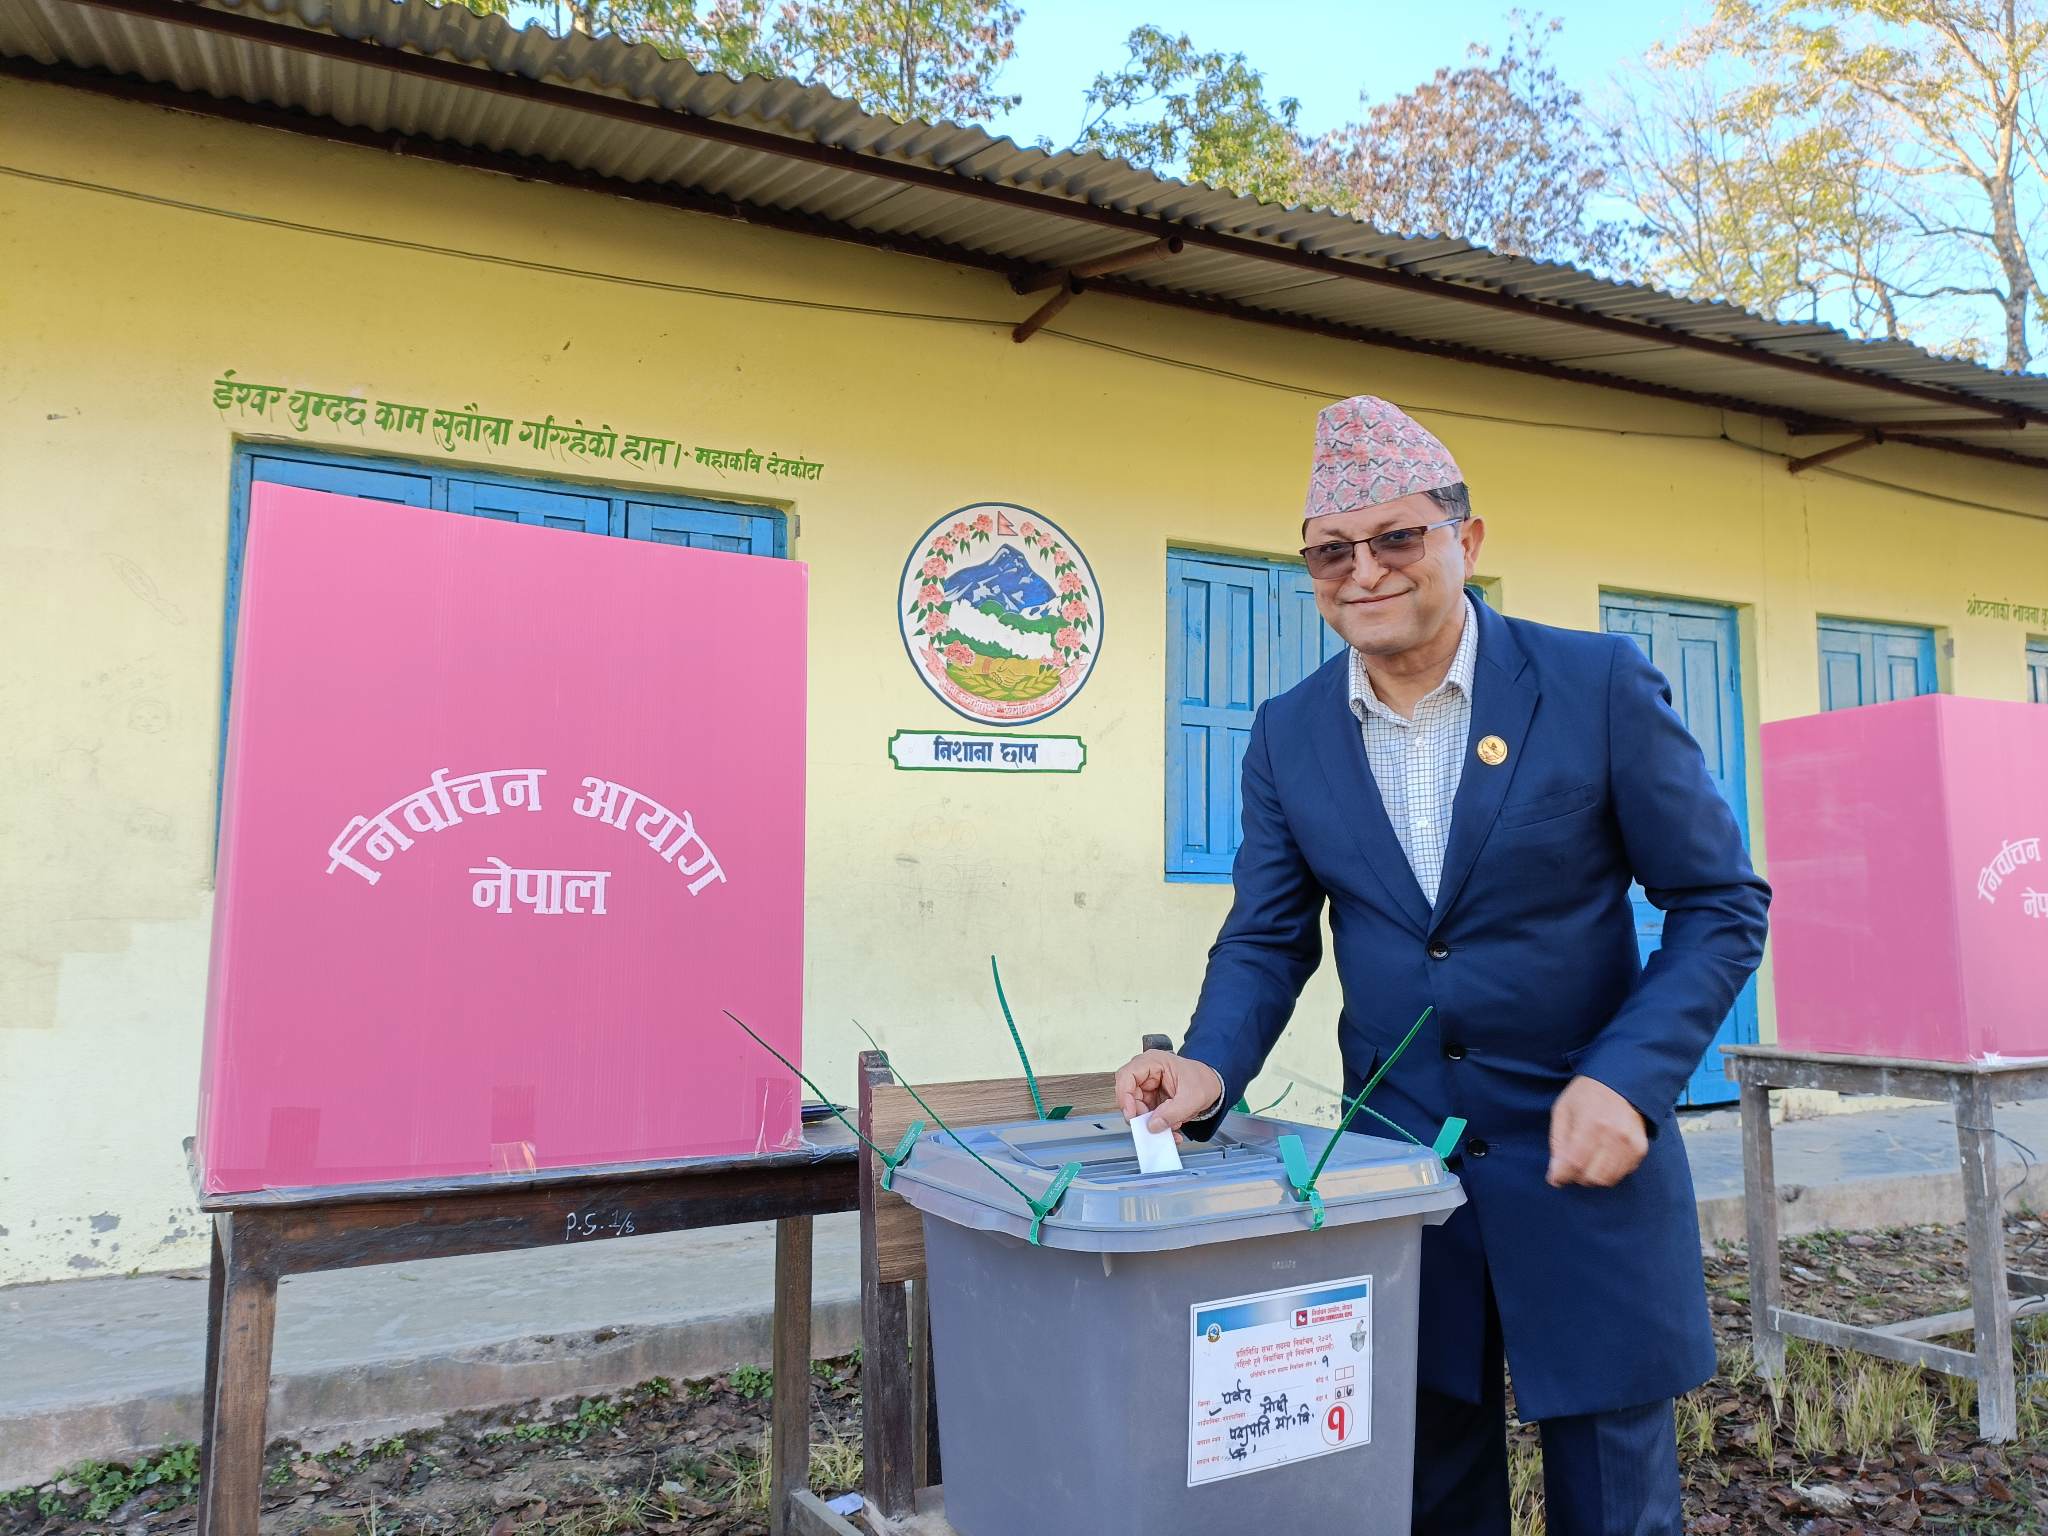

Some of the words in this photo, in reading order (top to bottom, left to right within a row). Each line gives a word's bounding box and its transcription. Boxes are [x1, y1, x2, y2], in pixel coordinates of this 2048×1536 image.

[213, 369, 287, 422] ईश्वर
[375, 400, 429, 434] काम
[432, 402, 513, 454] सुनौला
[695, 446, 764, 479] महाकवि
[766, 452, 824, 483] देवकोटा
[933, 735, 994, 763] निशाना
[999, 742, 1038, 768] छाप
[326, 767, 547, 886] निर्वाचन
[572, 776, 727, 896] आयोग
[469, 857, 611, 915] नेपाल
[1977, 837, 2041, 904] निर्वाचन
[1327, 1406, 1345, 1440] १
